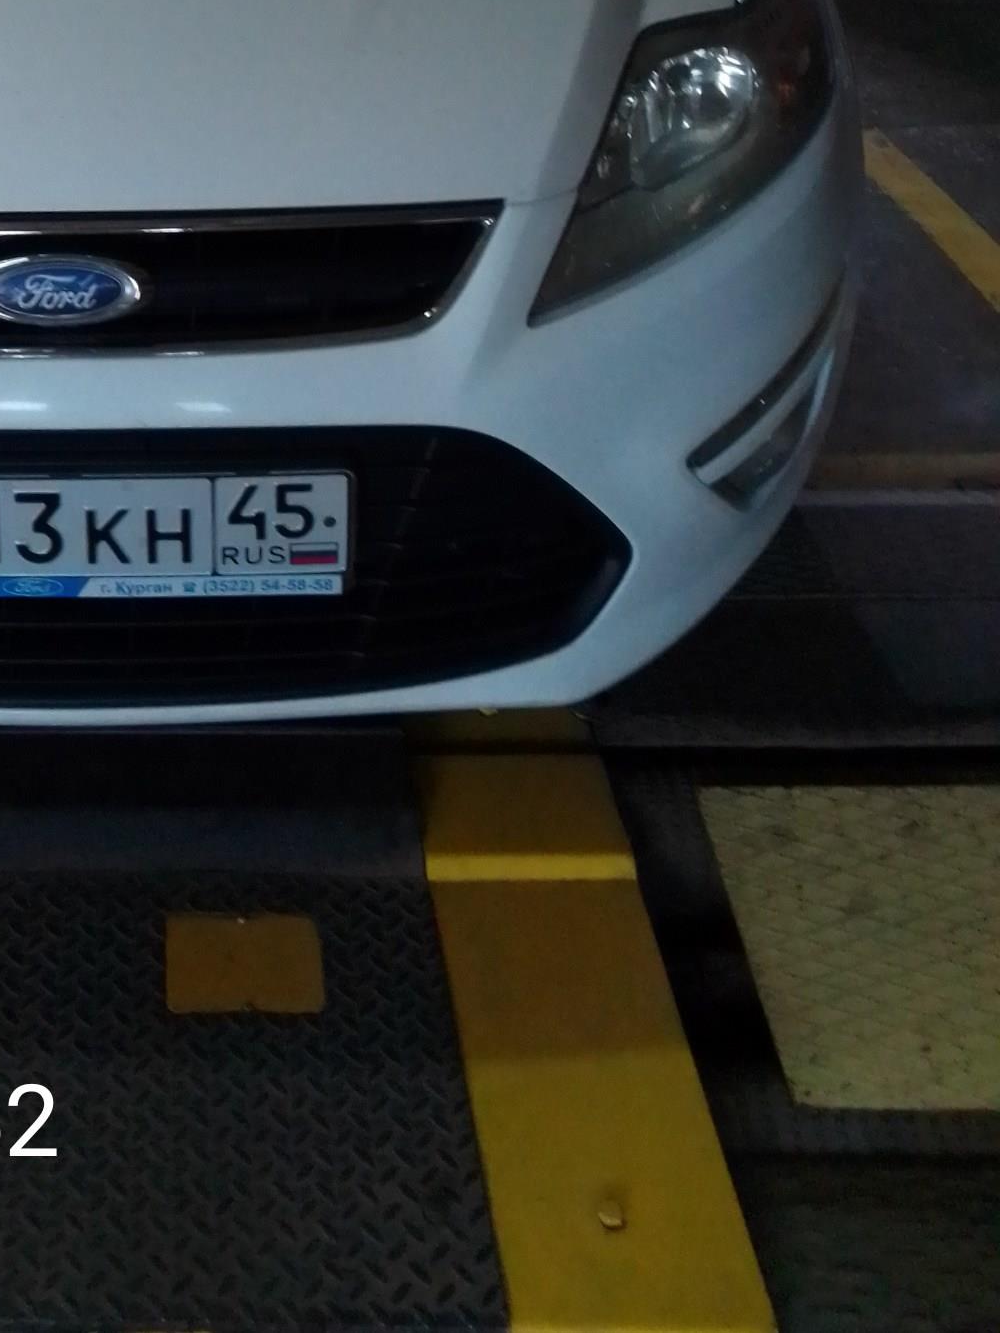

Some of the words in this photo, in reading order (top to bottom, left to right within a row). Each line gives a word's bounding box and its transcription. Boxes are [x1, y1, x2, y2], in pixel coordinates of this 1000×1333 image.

[15, 273, 97, 309] Ford
[227, 483, 315, 540] 45
[221, 545, 286, 565] RUS
[114, 581, 173, 596] Курган
[203, 579, 255, 594] (3522)
